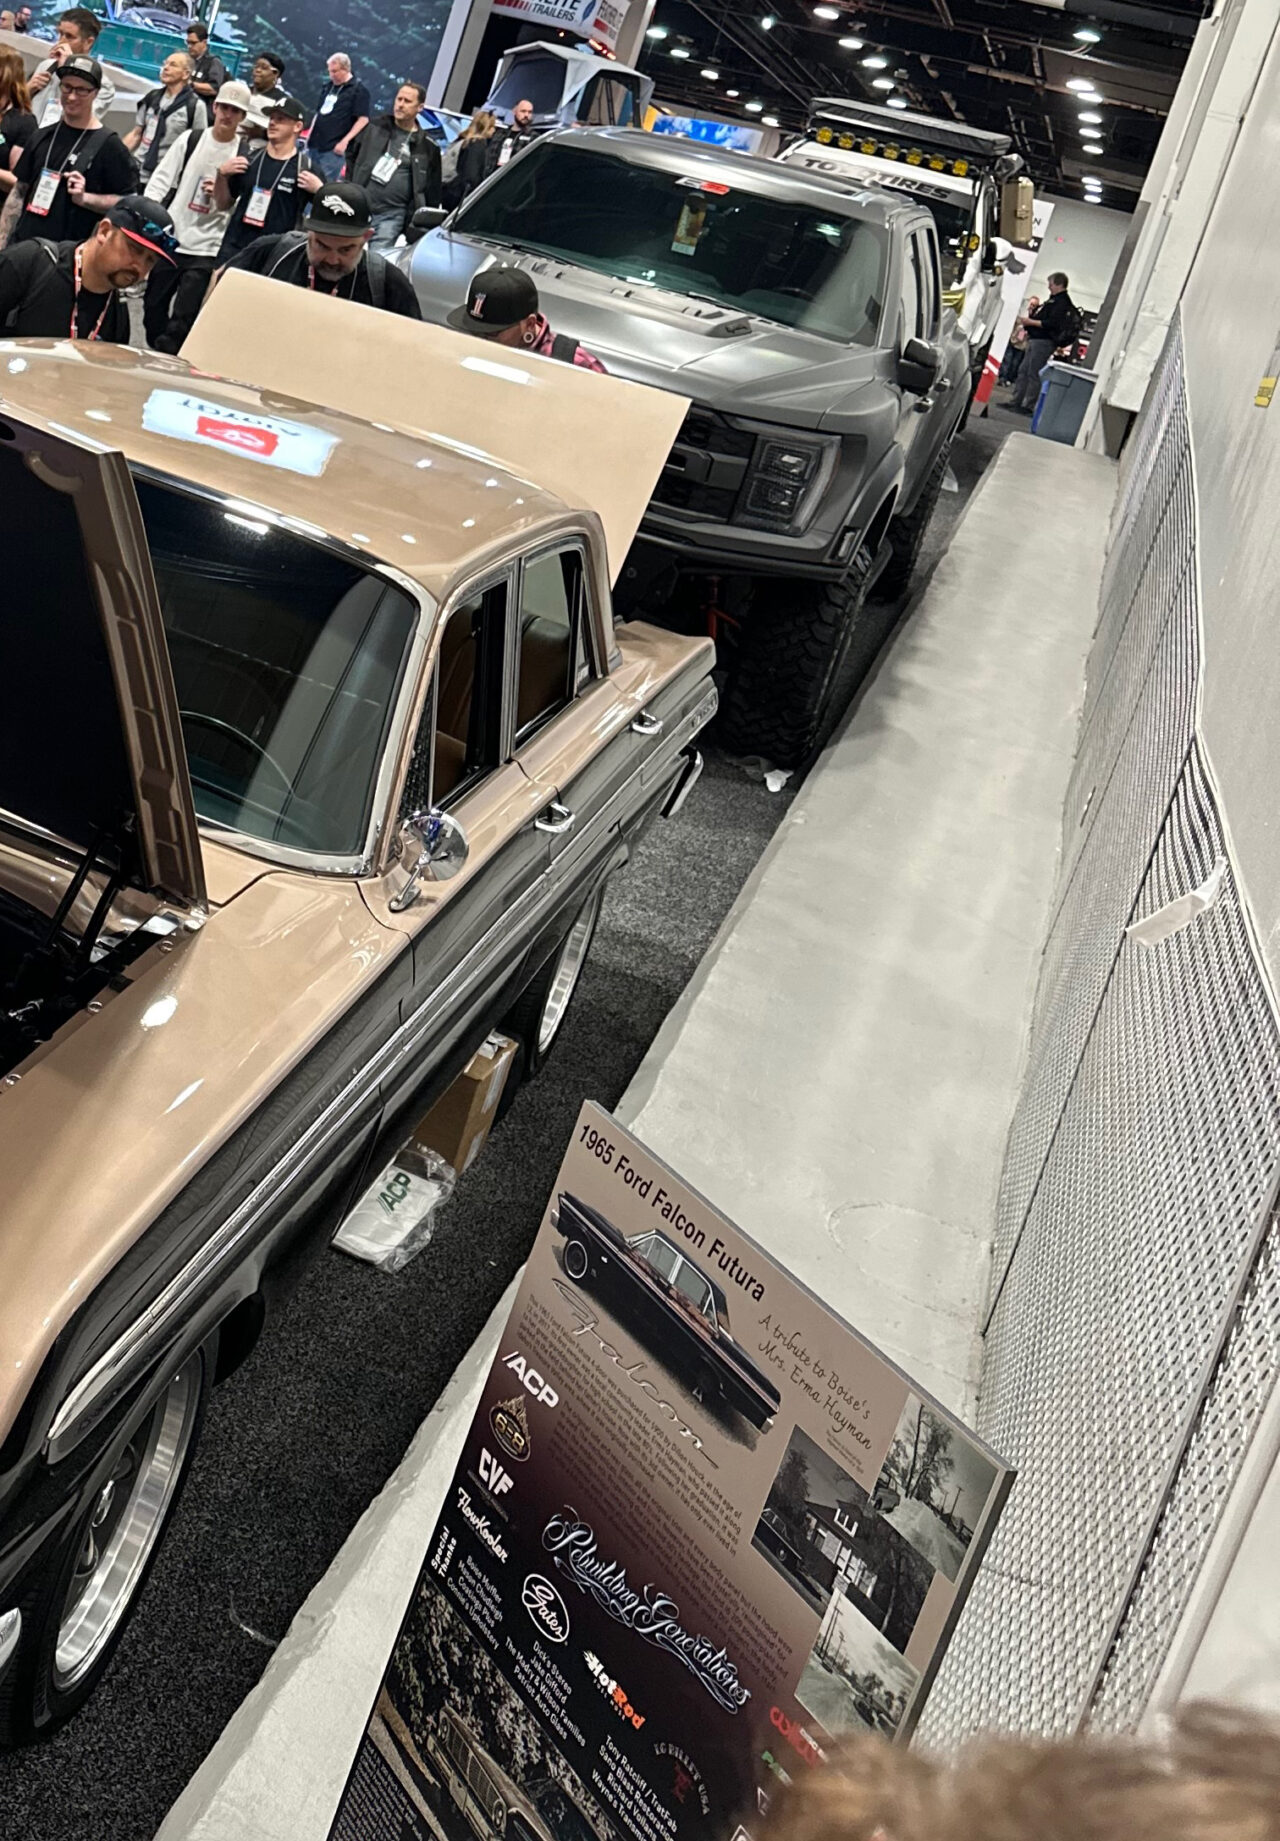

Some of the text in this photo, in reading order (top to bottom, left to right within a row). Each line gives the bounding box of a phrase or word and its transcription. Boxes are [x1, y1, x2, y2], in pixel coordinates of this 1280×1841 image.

[532, 2, 576, 22] TRAILERS
[875, 171, 952, 200] TIRES
[579, 1123, 766, 1303] 1965 Ford Falcon Futura
[552, 1277, 718, 1469] Falcon
[757, 1307, 873, 1422] A tribute to Boise's
[757, 1333, 790, 1373] Mrs.
[789, 1363, 824, 1405] Erma
[818, 1392, 875, 1461] Hayman
[478, 1447, 514, 1495] CVF
[430, 1524, 449, 1571] Special
[457, 1486, 508, 1564] FlowKooler
[437, 1533, 457, 1580] Thanks
[466, 1555, 482, 1579] Boise
[482, 1575, 501, 1603] Muffler
[447, 1576, 499, 1650] Connie's Upholstery
[458, 1560, 475, 1586] Mason
[475, 1583, 502, 1622] Chudleigh
[458, 1576, 481, 1610] Coatings
[482, 1607, 494, 1627] Plus
[531, 1582, 566, 1636] Gates
[544, 1505, 644, 1624] Rebuilding
[642, 1582, 752, 1714] Generations
[530, 1654, 566, 1704] Jake Gifford
[533, 1641, 571, 1694] Dick's Stereo
[512, 1646, 534, 1680] Madry
[534, 1675, 539, 1685] &
[539, 1681, 560, 1713] Wilson
[560, 1709, 585, 1746] Families
[514, 1665, 567, 1739] Patriot Auto Glass
[592, 1678, 625, 1722] FUEL HOSE
[591, 1769, 617, 1809] Wayne's
[599, 1744, 616, 1770] Sano
[616, 1766, 634, 1794] Blast
[604, 1735, 677, 1832] Tony Ratcliff / TratFab
[607, 1772, 657, 1841] Richard Vollans
[698, 1783, 710, 1815] USA
